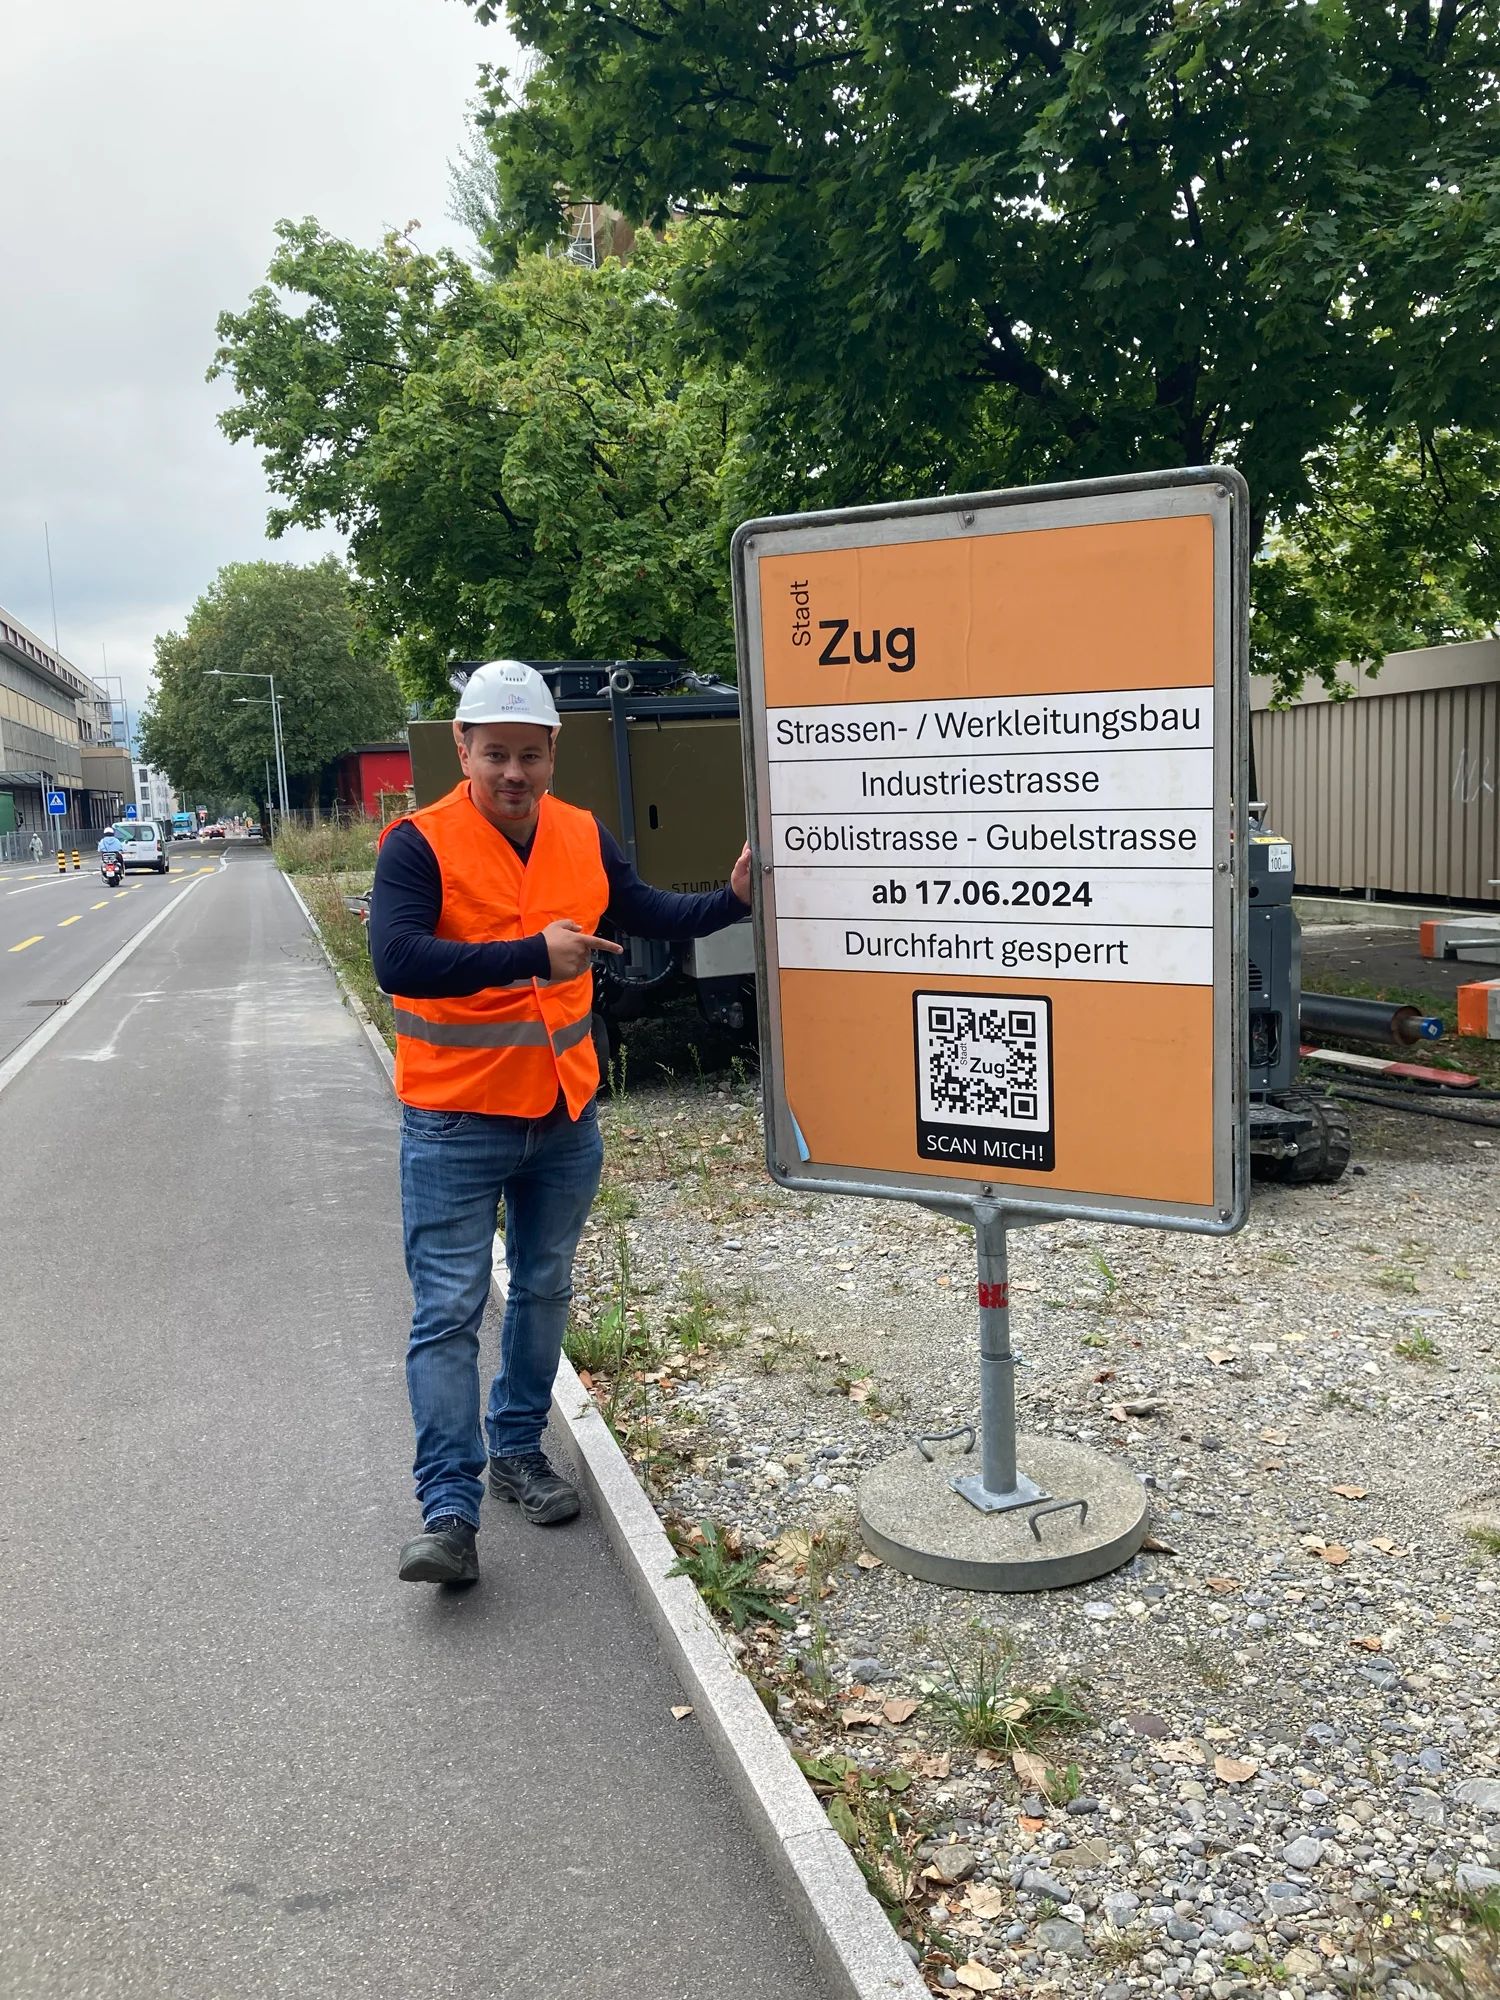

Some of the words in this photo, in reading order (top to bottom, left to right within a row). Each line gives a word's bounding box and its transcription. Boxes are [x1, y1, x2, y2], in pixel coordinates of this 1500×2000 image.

[789, 579, 812, 647] Stadt
[818, 618, 917, 673] Zug
[776, 718, 909, 745] Strassen-
[916, 713, 928, 740] /
[935, 703, 1201, 740] Werkleitungsbau
[861, 767, 1100, 797] Industriestrasse
[784, 825, 958, 854] Göblistrasse
[986, 823, 1198, 851] Gubelstrasse
[1271, 857, 1281, 870] 100
[872, 879, 907, 905] ab
[915, 880, 1093, 907] 17.06.2024
[845, 931, 994, 960] Durchfahrt
[1001, 938, 1129, 969] gesperrt
[959, 1042, 968, 1066] Stadt
[969, 1056, 1005, 1079] Zug
[926, 1134, 977, 1155] SCAN
[983, 1140, 1044, 1162] MICH!
